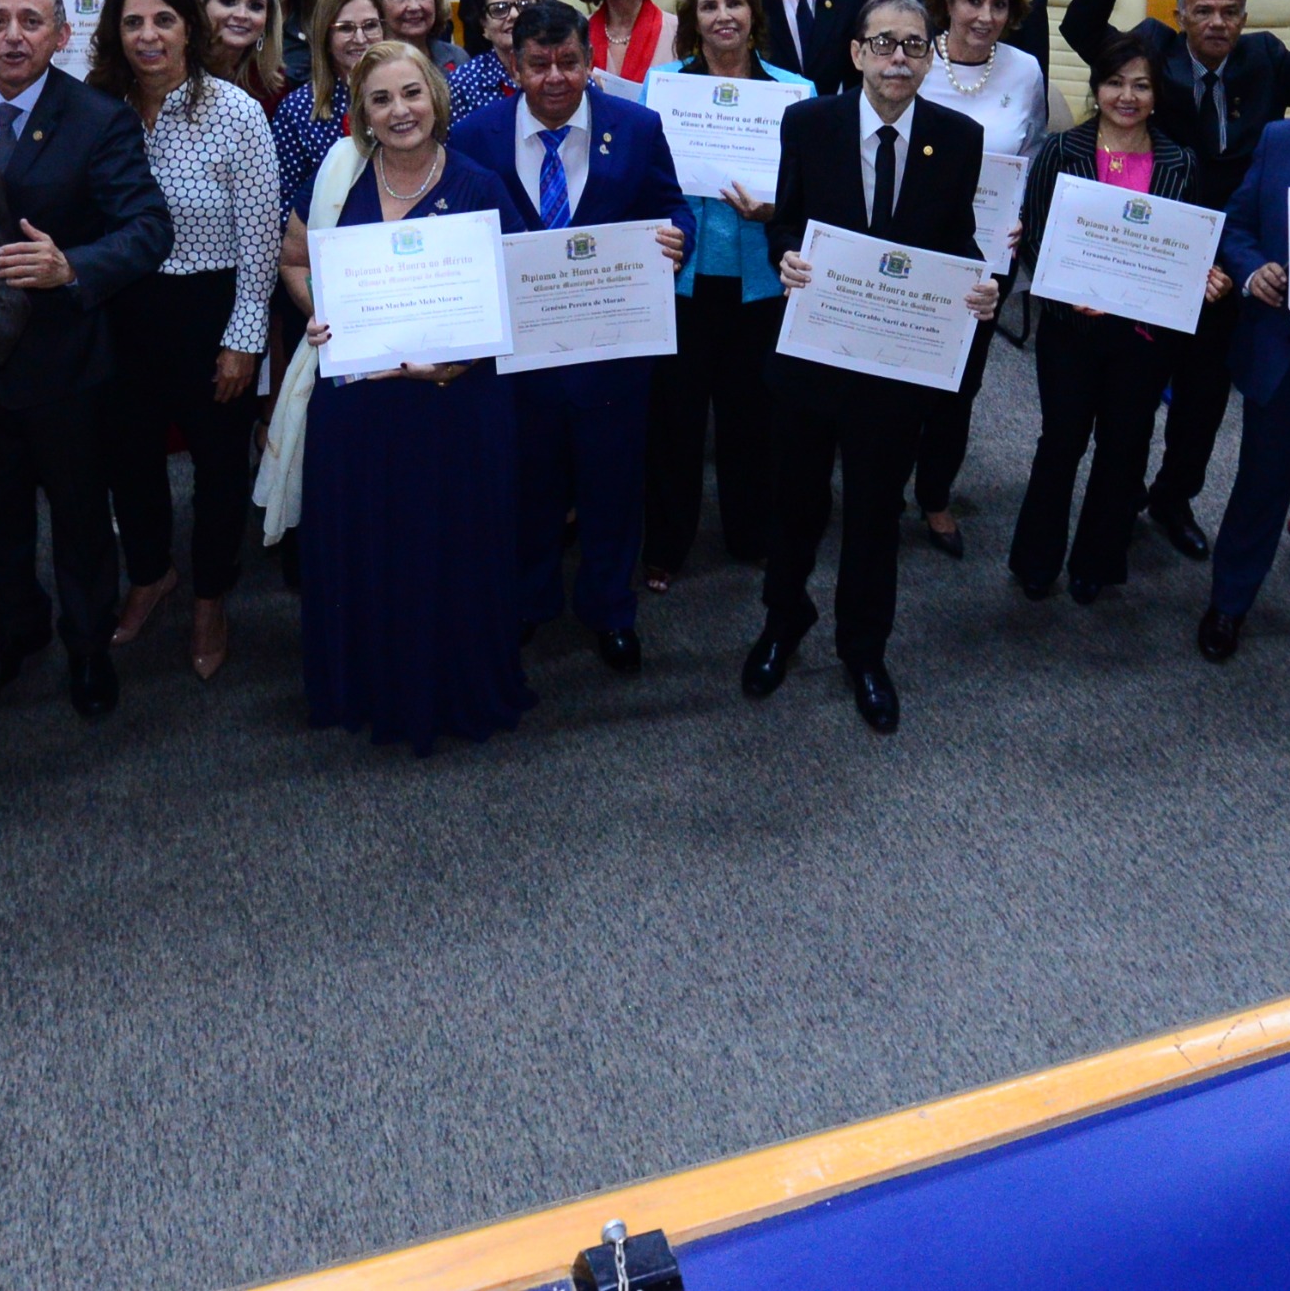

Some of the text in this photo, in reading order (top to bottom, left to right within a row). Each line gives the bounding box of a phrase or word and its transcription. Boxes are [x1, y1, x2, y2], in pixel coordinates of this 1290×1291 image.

[521, 273, 556, 283] Diploma
[559, 269, 568, 278] de
[572, 267, 598, 277] Honra
[615, 262, 643, 271] Mérito
[827, 269, 862, 286] Diploma
[866, 279, 875, 289] de
[878, 282, 905, 296] Honra
[922, 292, 951, 305] Mérito
